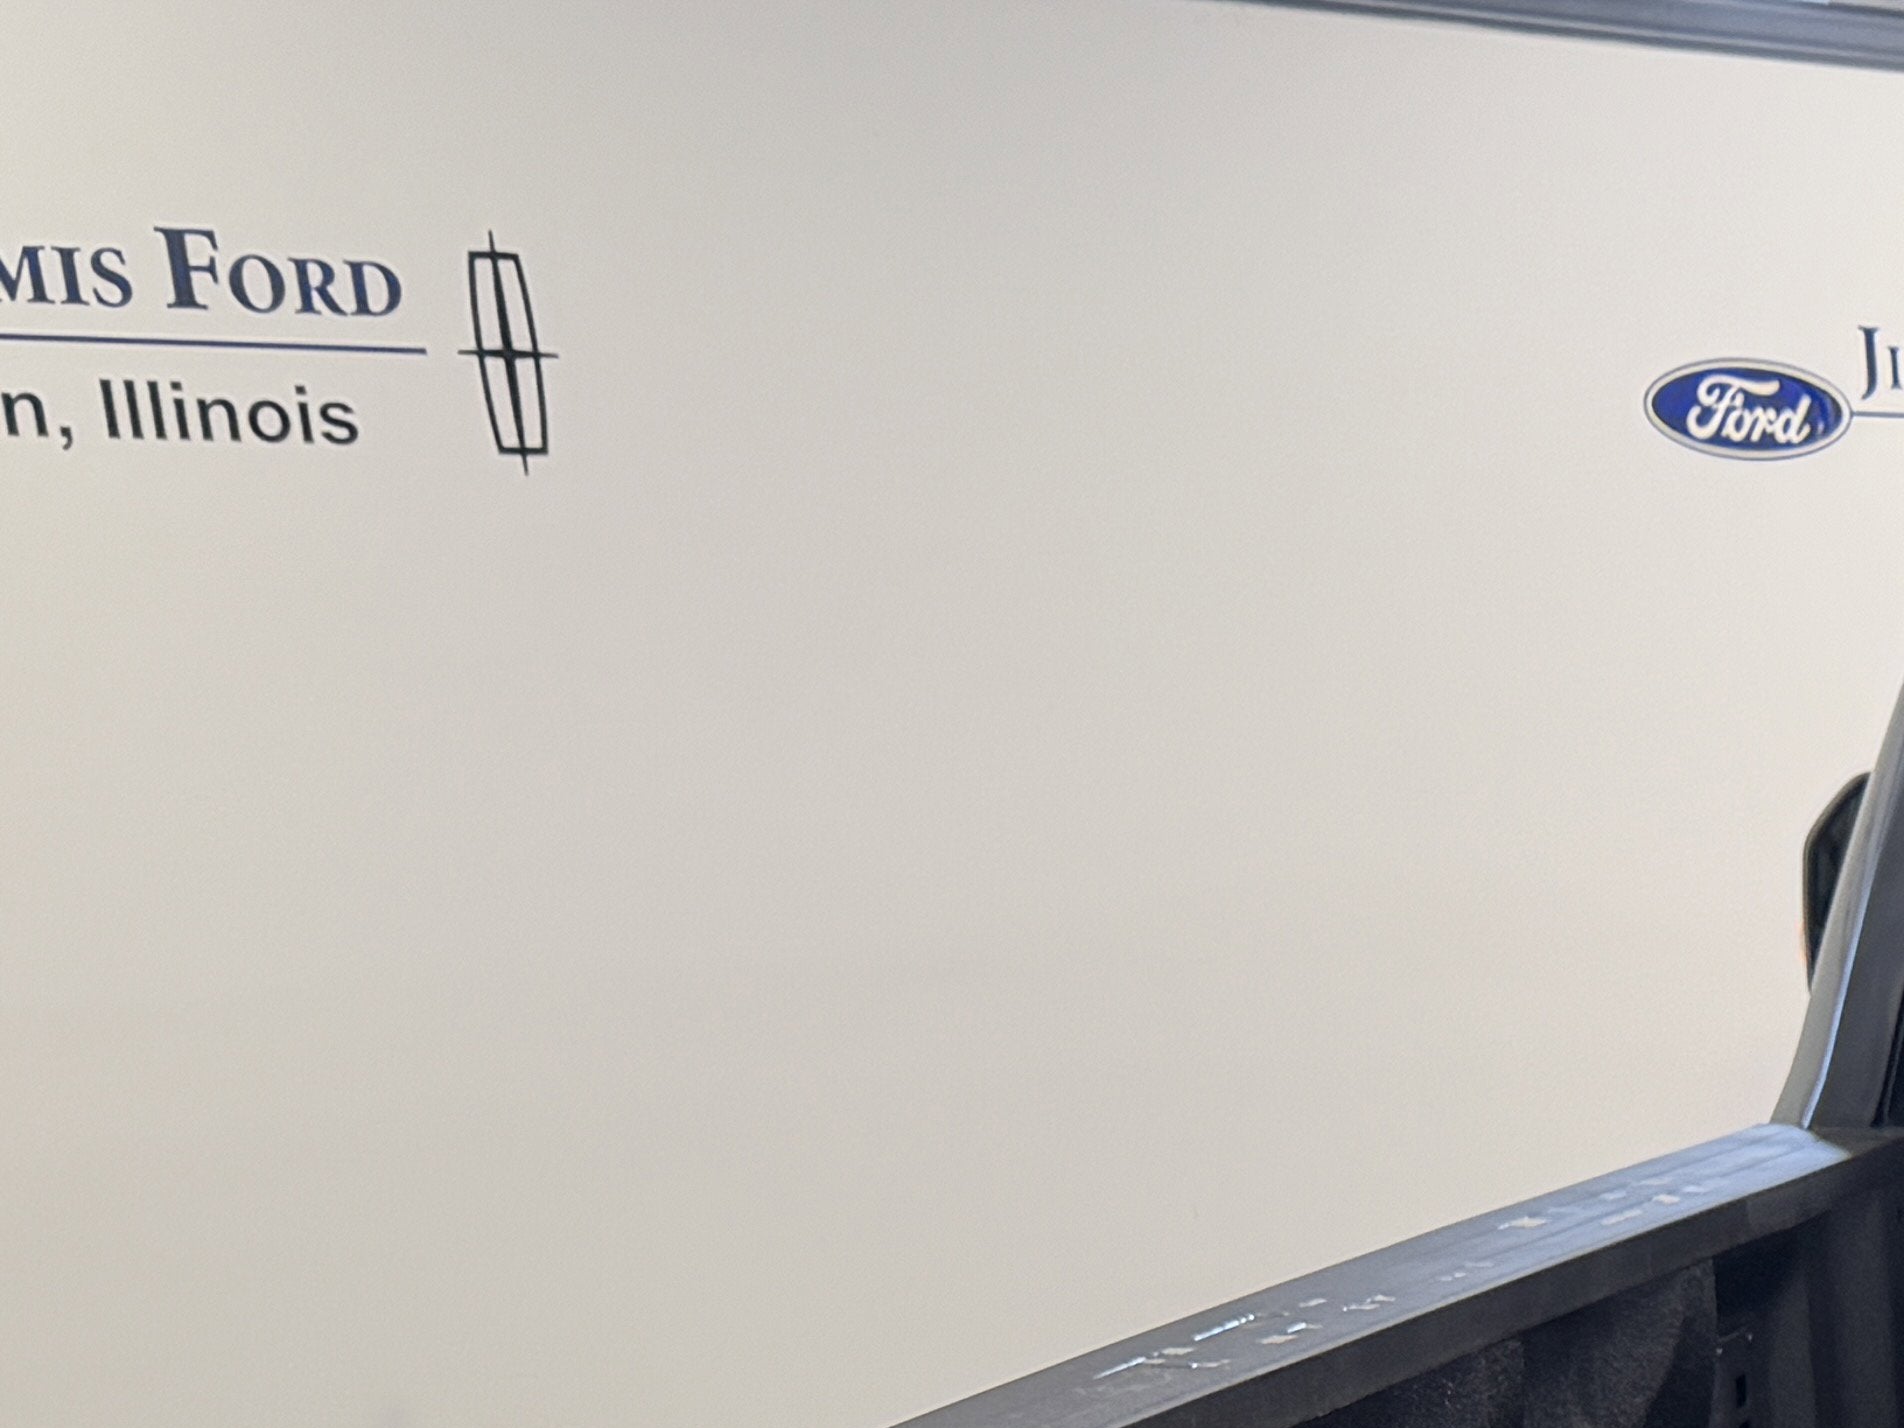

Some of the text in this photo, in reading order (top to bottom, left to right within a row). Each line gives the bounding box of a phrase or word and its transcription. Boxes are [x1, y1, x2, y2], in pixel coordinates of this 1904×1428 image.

[0, 226, 403, 318] MIS FORD
[99, 379, 360, 445] Illinois
[1685, 373, 1812, 445] Ford
